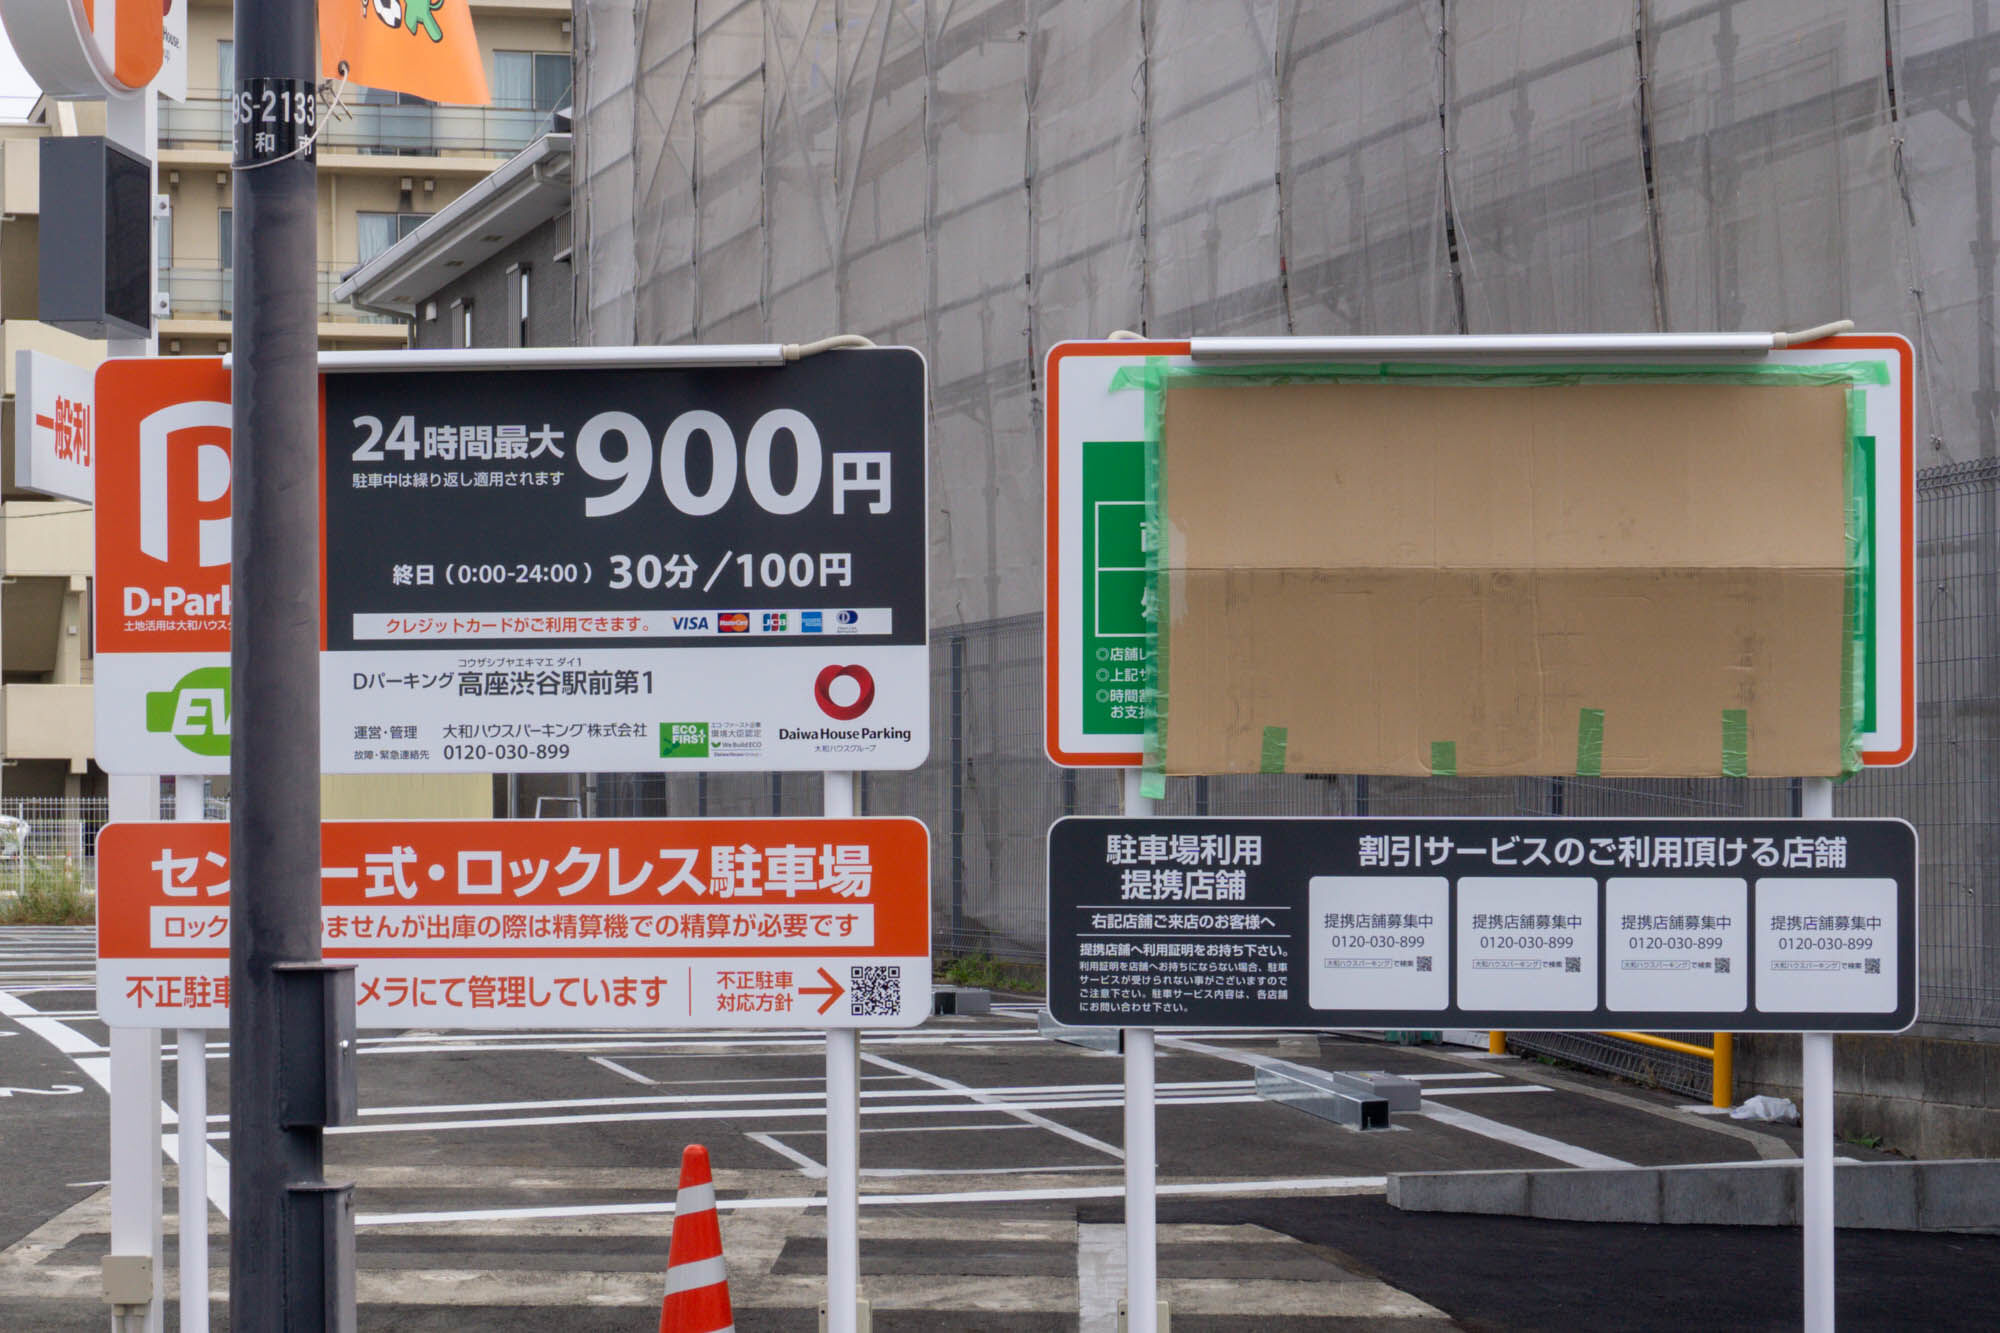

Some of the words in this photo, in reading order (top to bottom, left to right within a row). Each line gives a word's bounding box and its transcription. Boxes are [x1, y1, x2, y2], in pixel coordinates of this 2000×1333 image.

[36, 394, 90, 467] 一般利
[352, 415, 565, 461] 24時間最大
[575, 407, 892, 518] 900円
[352, 471, 565, 488] 駐車中は繰り返し適用されます
[386, 616, 650, 634] クレジットカードがご利用できます。
[672, 616, 709, 630] VISA
[458, 658, 554, 668] コウザシブヤエキマエ
[458, 670, 654, 697] 高座渋谷駅前第1
[354, 725, 418, 740] 運営・管理
[443, 723, 648, 739] 大和ハウスパーキング株式会社
[672, 725, 697, 735] ECO
[779, 728, 819, 740] Daiwa
[820, 728, 860, 740] House
[861, 727, 912, 743] Parking
[672, 734, 705, 744] FIRST
[444, 744, 571, 760] 0120-030-899
[1106, 834, 1263, 866] 駐車場利用
[1358, 835, 1848, 869] 割引サービスのご利用頂ける店舗
[152, 844, 873, 899] センー式・ロックレス駐車場
[1121, 869, 1247, 901] 提携店舗
[1091, 913, 1276, 930] 右記店舗ご来店のお客様へ
[1324, 913, 1433, 929] 提携店舗募集中
[1472, 914, 1582, 930] 提携店舗募集中
[1621, 915, 1731, 931] 提携店舗募集中
[1771, 916, 1882, 932] 提携店舗募集中
[1079, 943, 1288, 957] 提携店舗へ利用証明をお持ち下さい。
[1332, 936, 1425, 949] 0120-030-899
[1480, 936, 1574, 949] 0120-030-899
[1629, 937, 1723, 950] 0120-030-899
[1779, 938, 1873, 951] 0120-030-899
[716, 970, 793, 990] 不正駐車
[716, 992, 793, 1013] 対応方針
